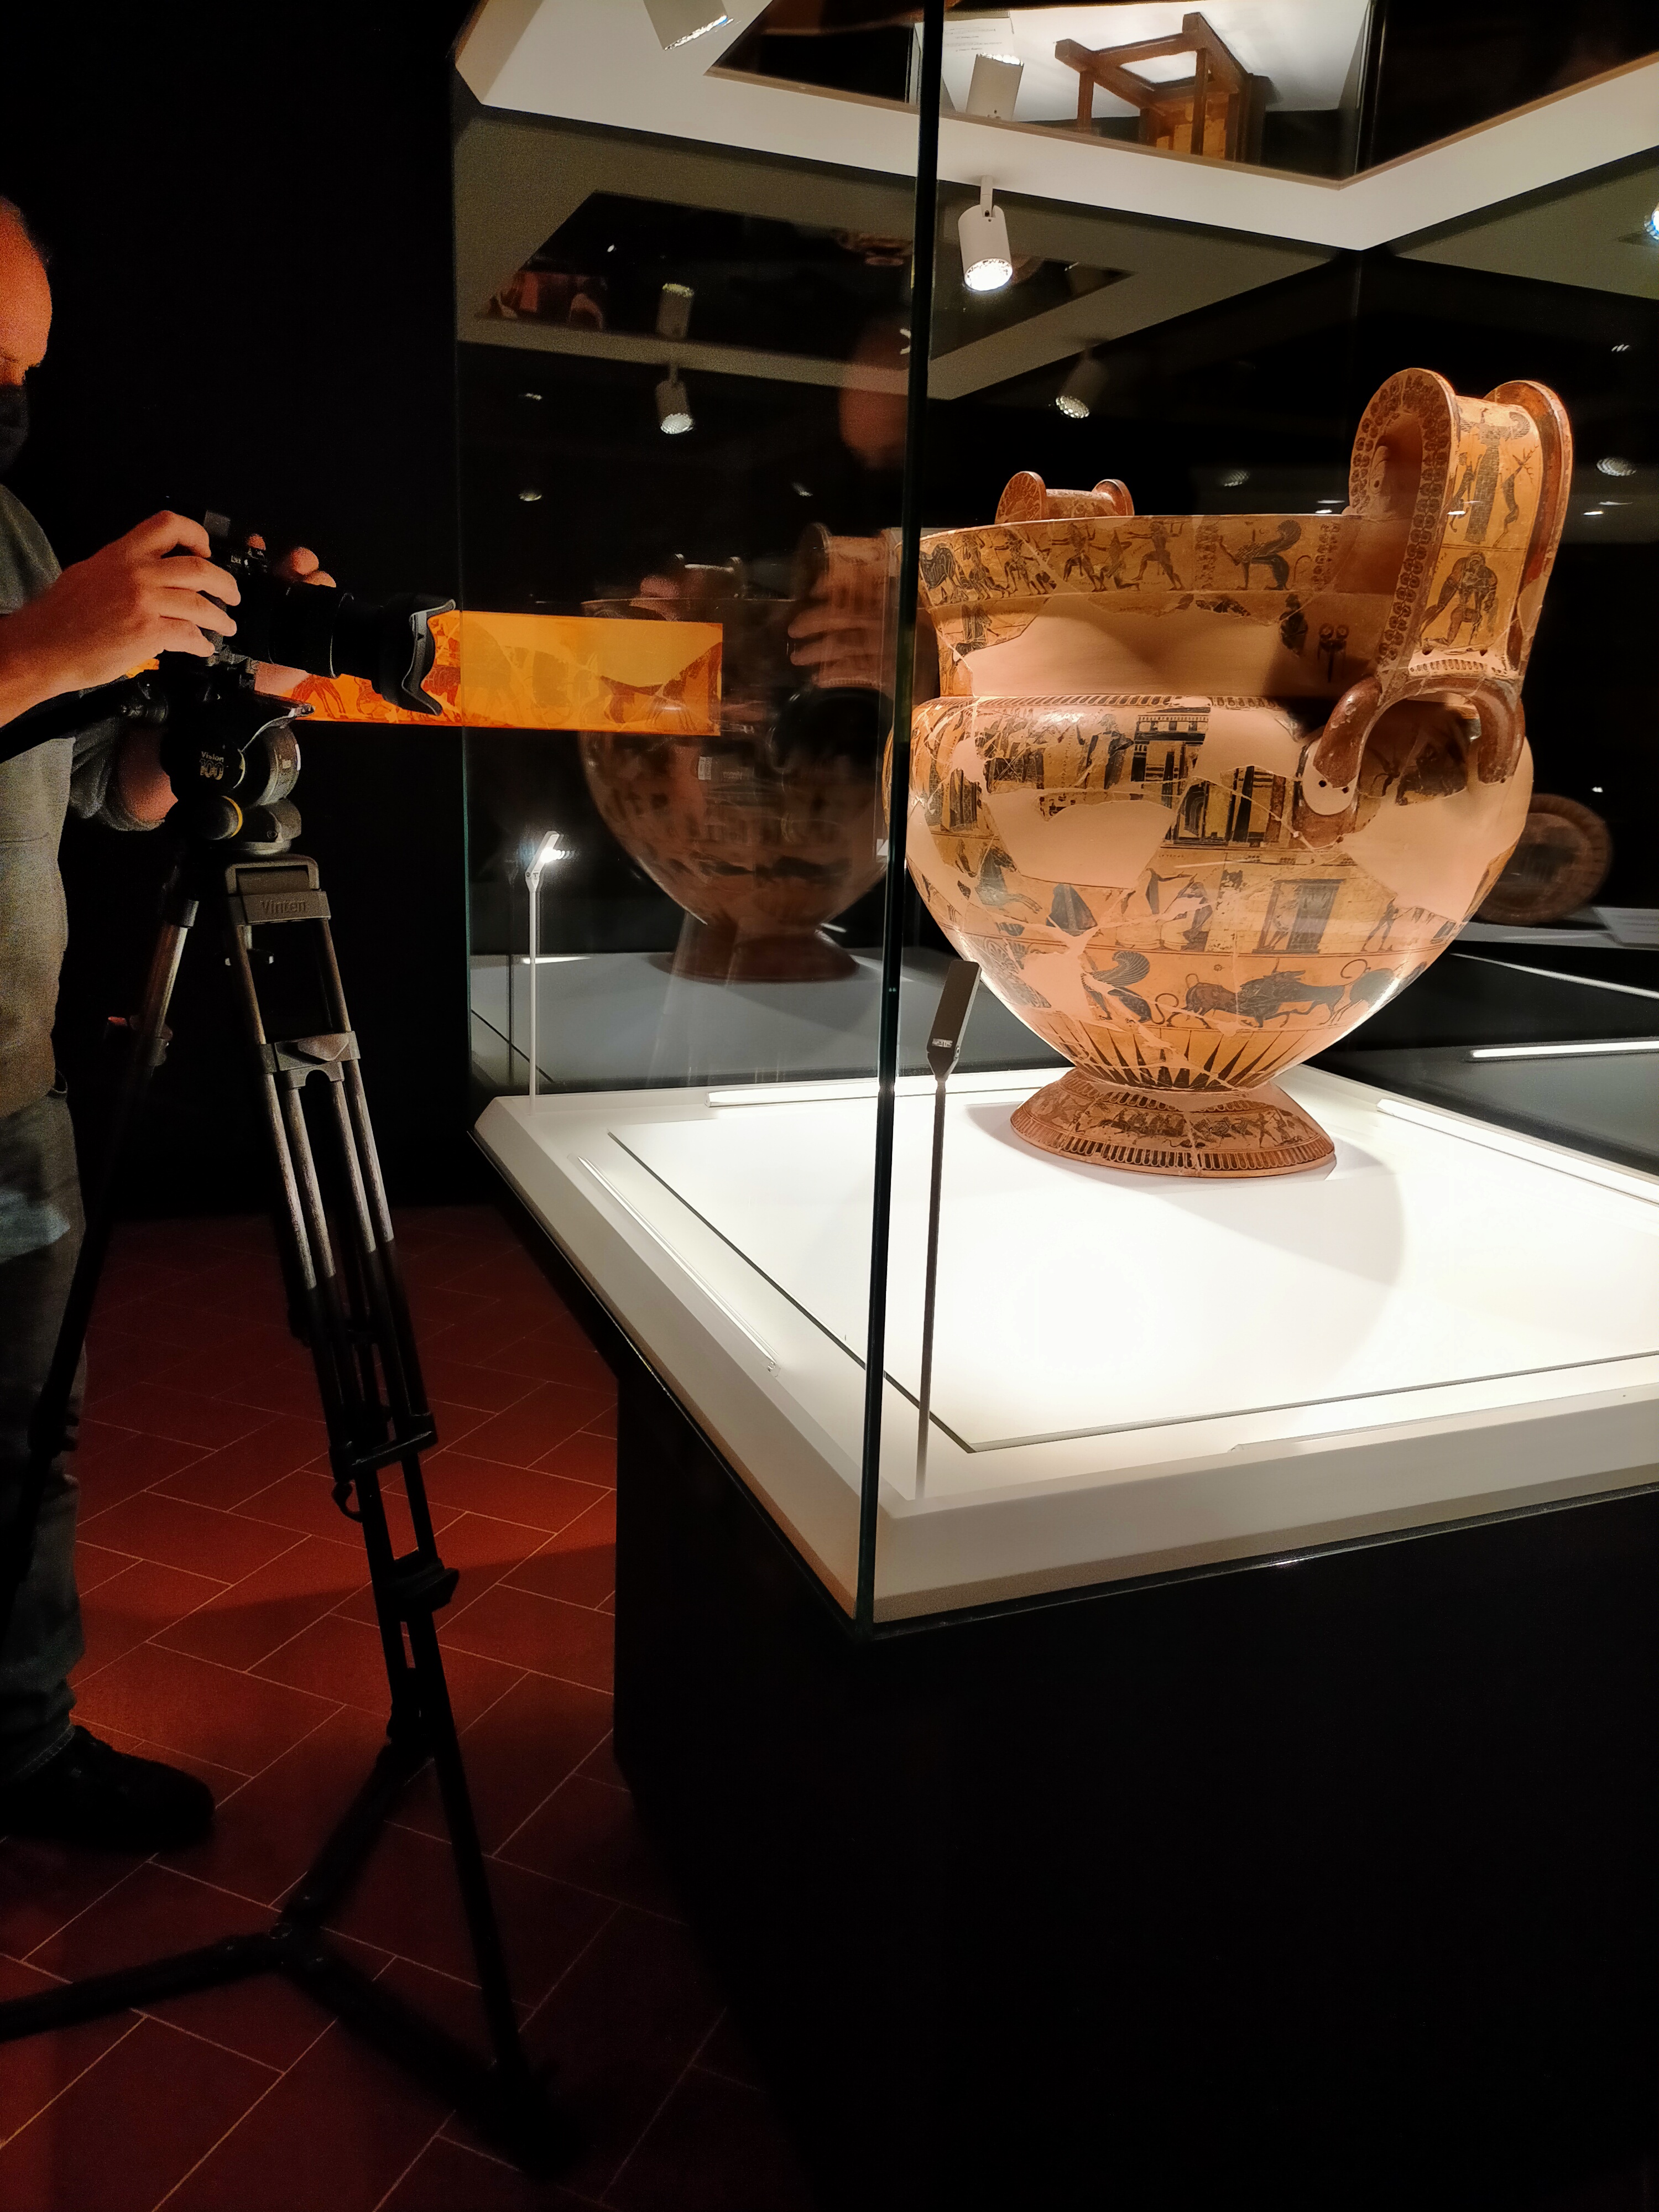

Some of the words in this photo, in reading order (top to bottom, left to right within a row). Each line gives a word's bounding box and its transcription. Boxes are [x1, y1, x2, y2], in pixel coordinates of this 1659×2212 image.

[201, 751, 225, 763] Vision
[200, 758, 224, 780] 100
[260, 899, 306, 914] Vinten
